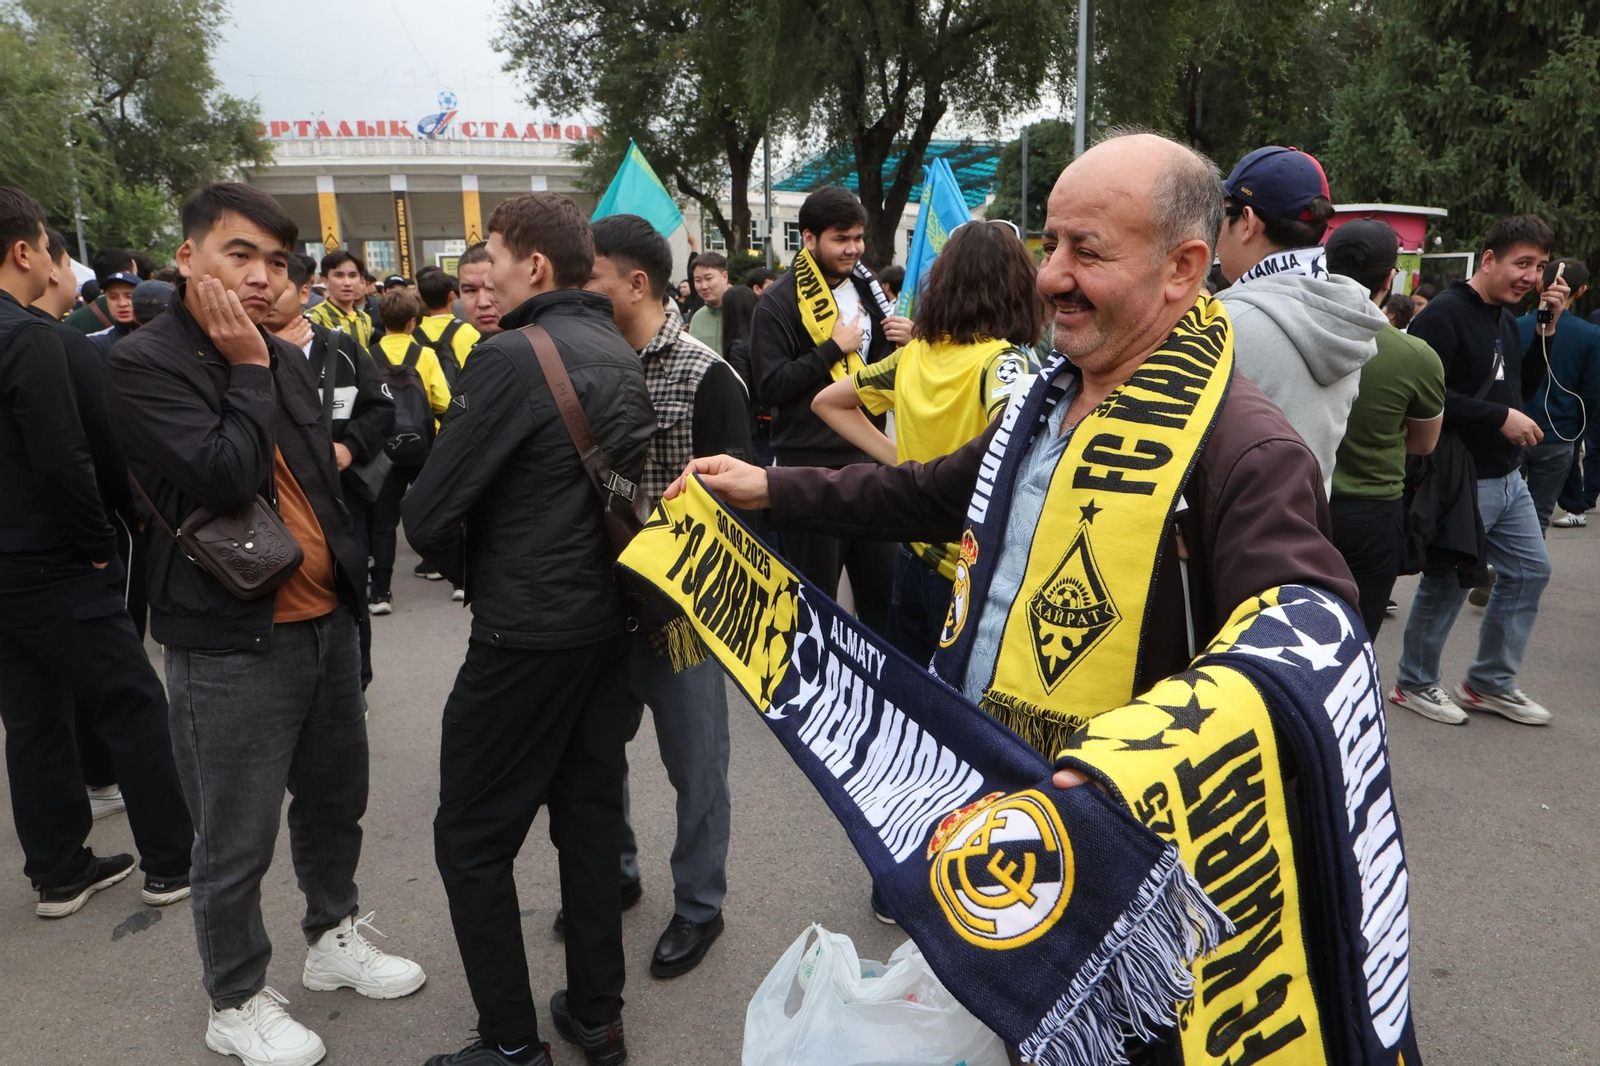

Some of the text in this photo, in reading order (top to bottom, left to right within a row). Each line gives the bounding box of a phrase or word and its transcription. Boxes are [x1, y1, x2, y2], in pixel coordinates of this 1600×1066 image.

[1072, 433, 1173, 496] FC
[715, 509, 771, 581] 30.09.2025
[693, 537, 770, 667] KAIRAT
[830, 615, 887, 681] ALMATY
[1035, 599, 1100, 626] КАЙРАТ
[797, 650, 875, 780] REAL
[843, 698, 985, 864] MADRID
[1323, 650, 1386, 833] REAL
[1174, 728, 1285, 1008] KAIRAT
